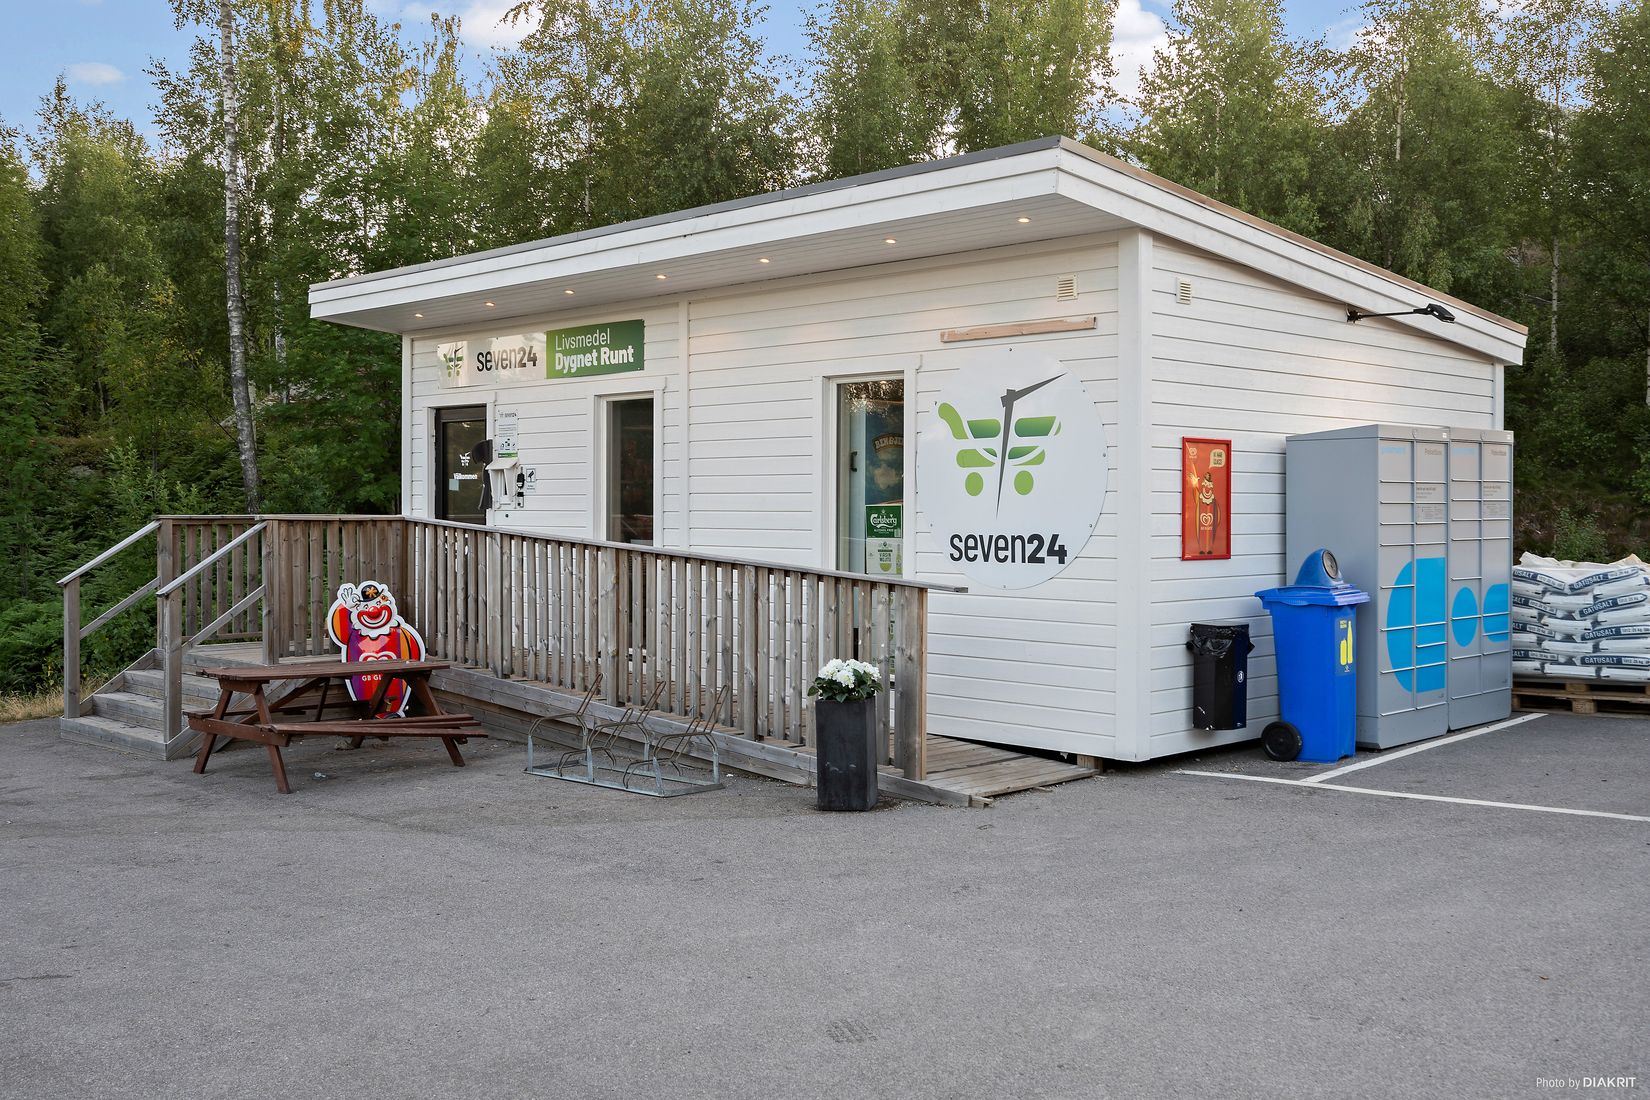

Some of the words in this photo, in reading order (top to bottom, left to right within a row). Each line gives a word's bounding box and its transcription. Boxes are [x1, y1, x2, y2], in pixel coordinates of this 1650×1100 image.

[555, 328, 610, 350] Livsmedel
[476, 346, 538, 372] seven24
[555, 350, 598, 373] Dygnet
[600, 345, 634, 366] Runt
[870, 514, 897, 528] Carlsberg
[950, 534, 1067, 564] seven24
[1574, 574, 1604, 588] GATUSALT
[1583, 600, 1613, 614] GATUSALT
[1584, 628, 1616, 638] GATUSALT
